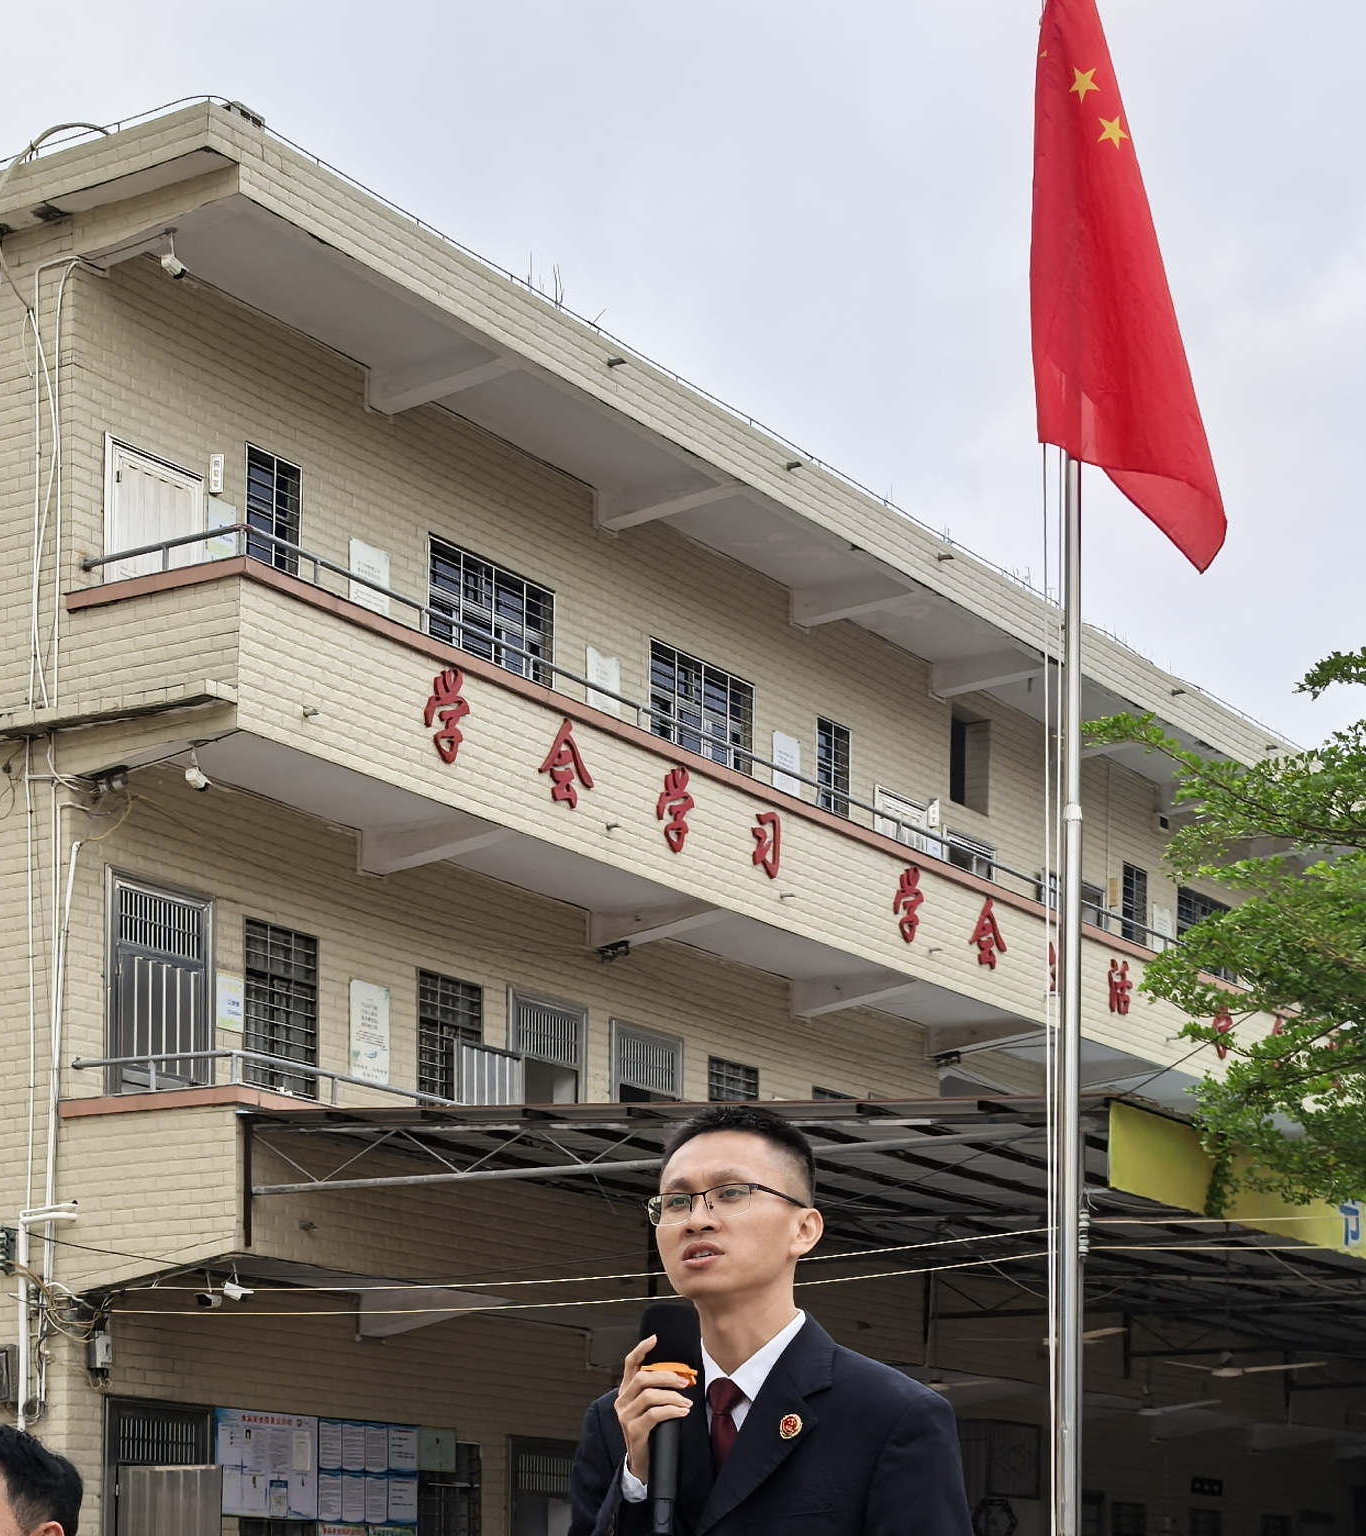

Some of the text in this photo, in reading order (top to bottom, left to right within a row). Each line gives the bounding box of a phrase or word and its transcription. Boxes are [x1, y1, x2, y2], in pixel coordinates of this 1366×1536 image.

[423, 667, 1134, 1016] 学会学习 学会活
